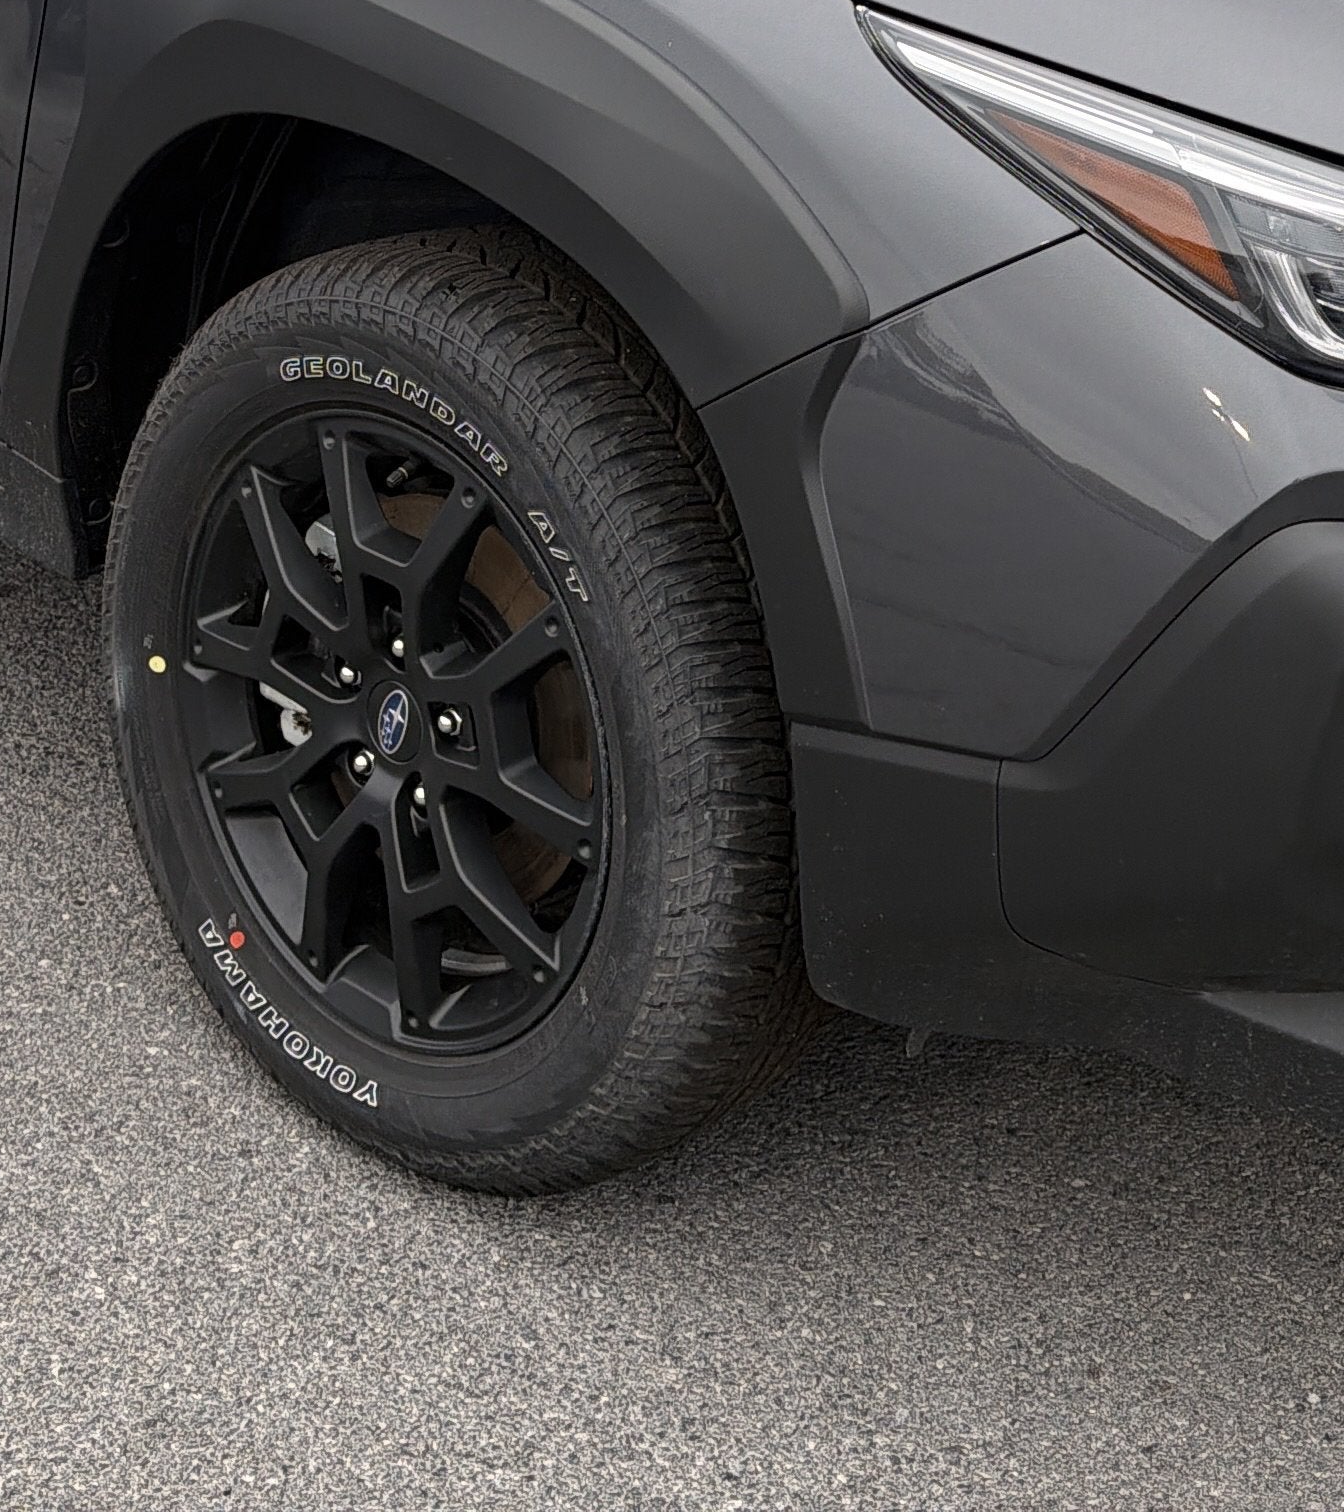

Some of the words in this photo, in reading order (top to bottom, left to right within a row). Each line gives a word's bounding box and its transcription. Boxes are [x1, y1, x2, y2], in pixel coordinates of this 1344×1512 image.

[279, 356, 508, 477] GEOLANDAR
[527, 511, 589, 602] A/T
[197, 917, 378, 1108] YOKOHAMA
